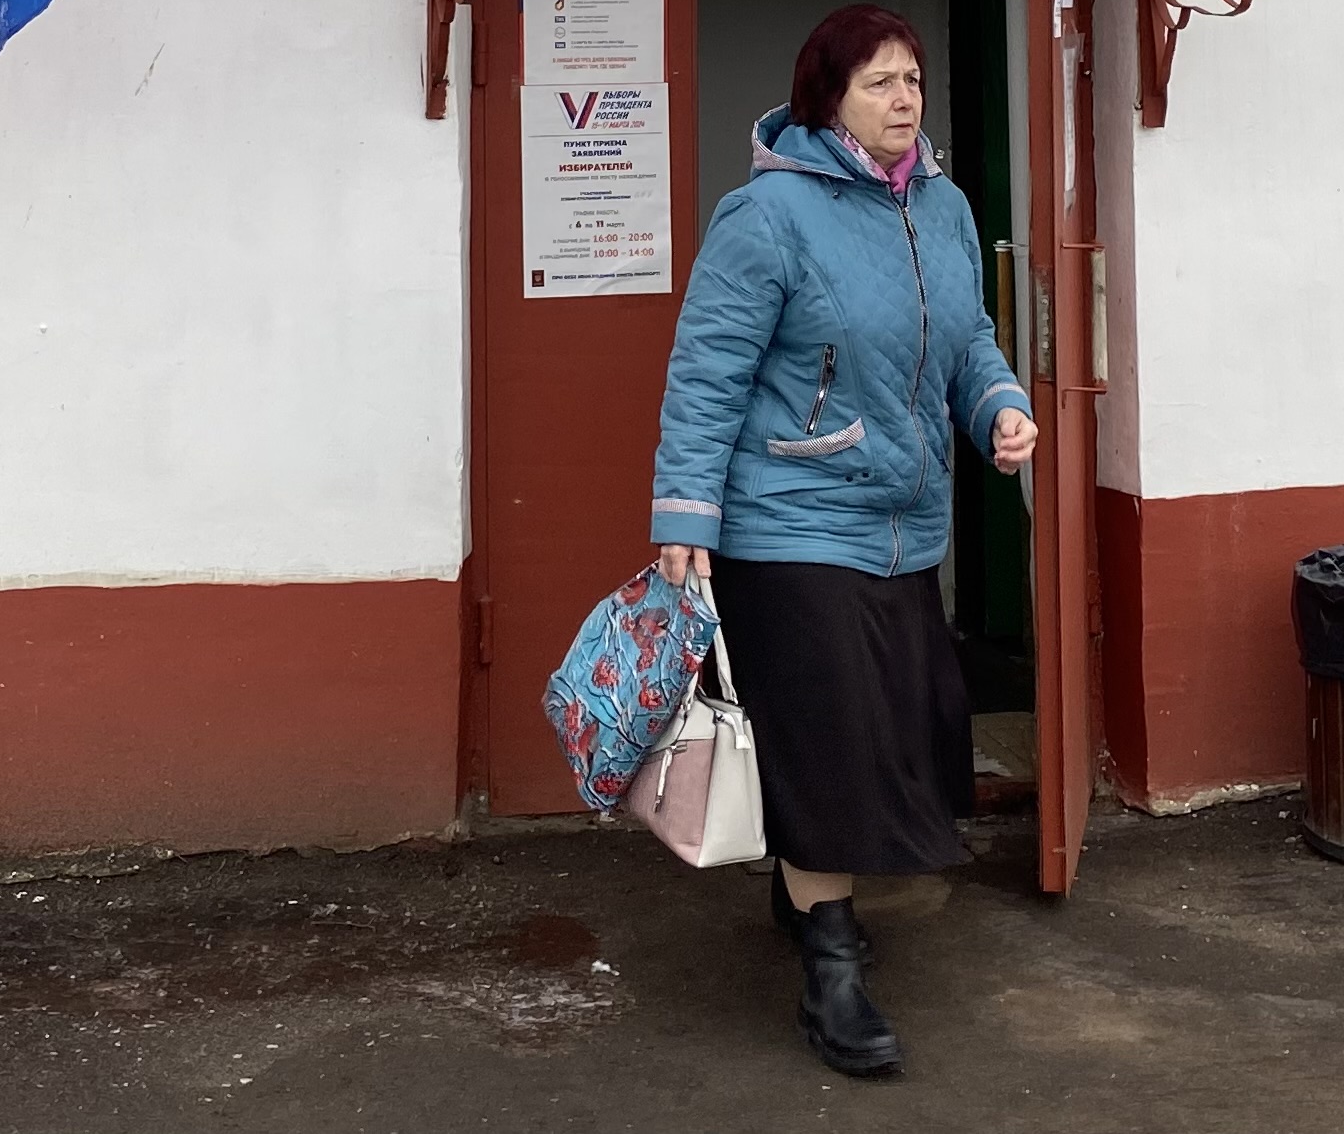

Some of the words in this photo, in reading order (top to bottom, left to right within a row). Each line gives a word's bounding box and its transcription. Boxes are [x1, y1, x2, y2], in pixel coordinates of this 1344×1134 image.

[603, 90, 641, 99] ВЫБОРЫ
[599, 100, 652, 110] ПРЕЗИДЕНТА
[594, 111, 629, 120] РОССИИ
[564, 140, 591, 148] ПУНКТ
[593, 139, 627, 147] ПРИЕМА
[572, 148, 622, 157] ЗАЯВЛЕНИЙ
[559, 161, 633, 172] ИЗБИРАТЕЛЕЙ
[593, 233, 618, 243] 16:00
[628, 232, 654, 242] 20:00
[593, 249, 619, 258] 10:00
[628, 247, 655, 257] 14:00
